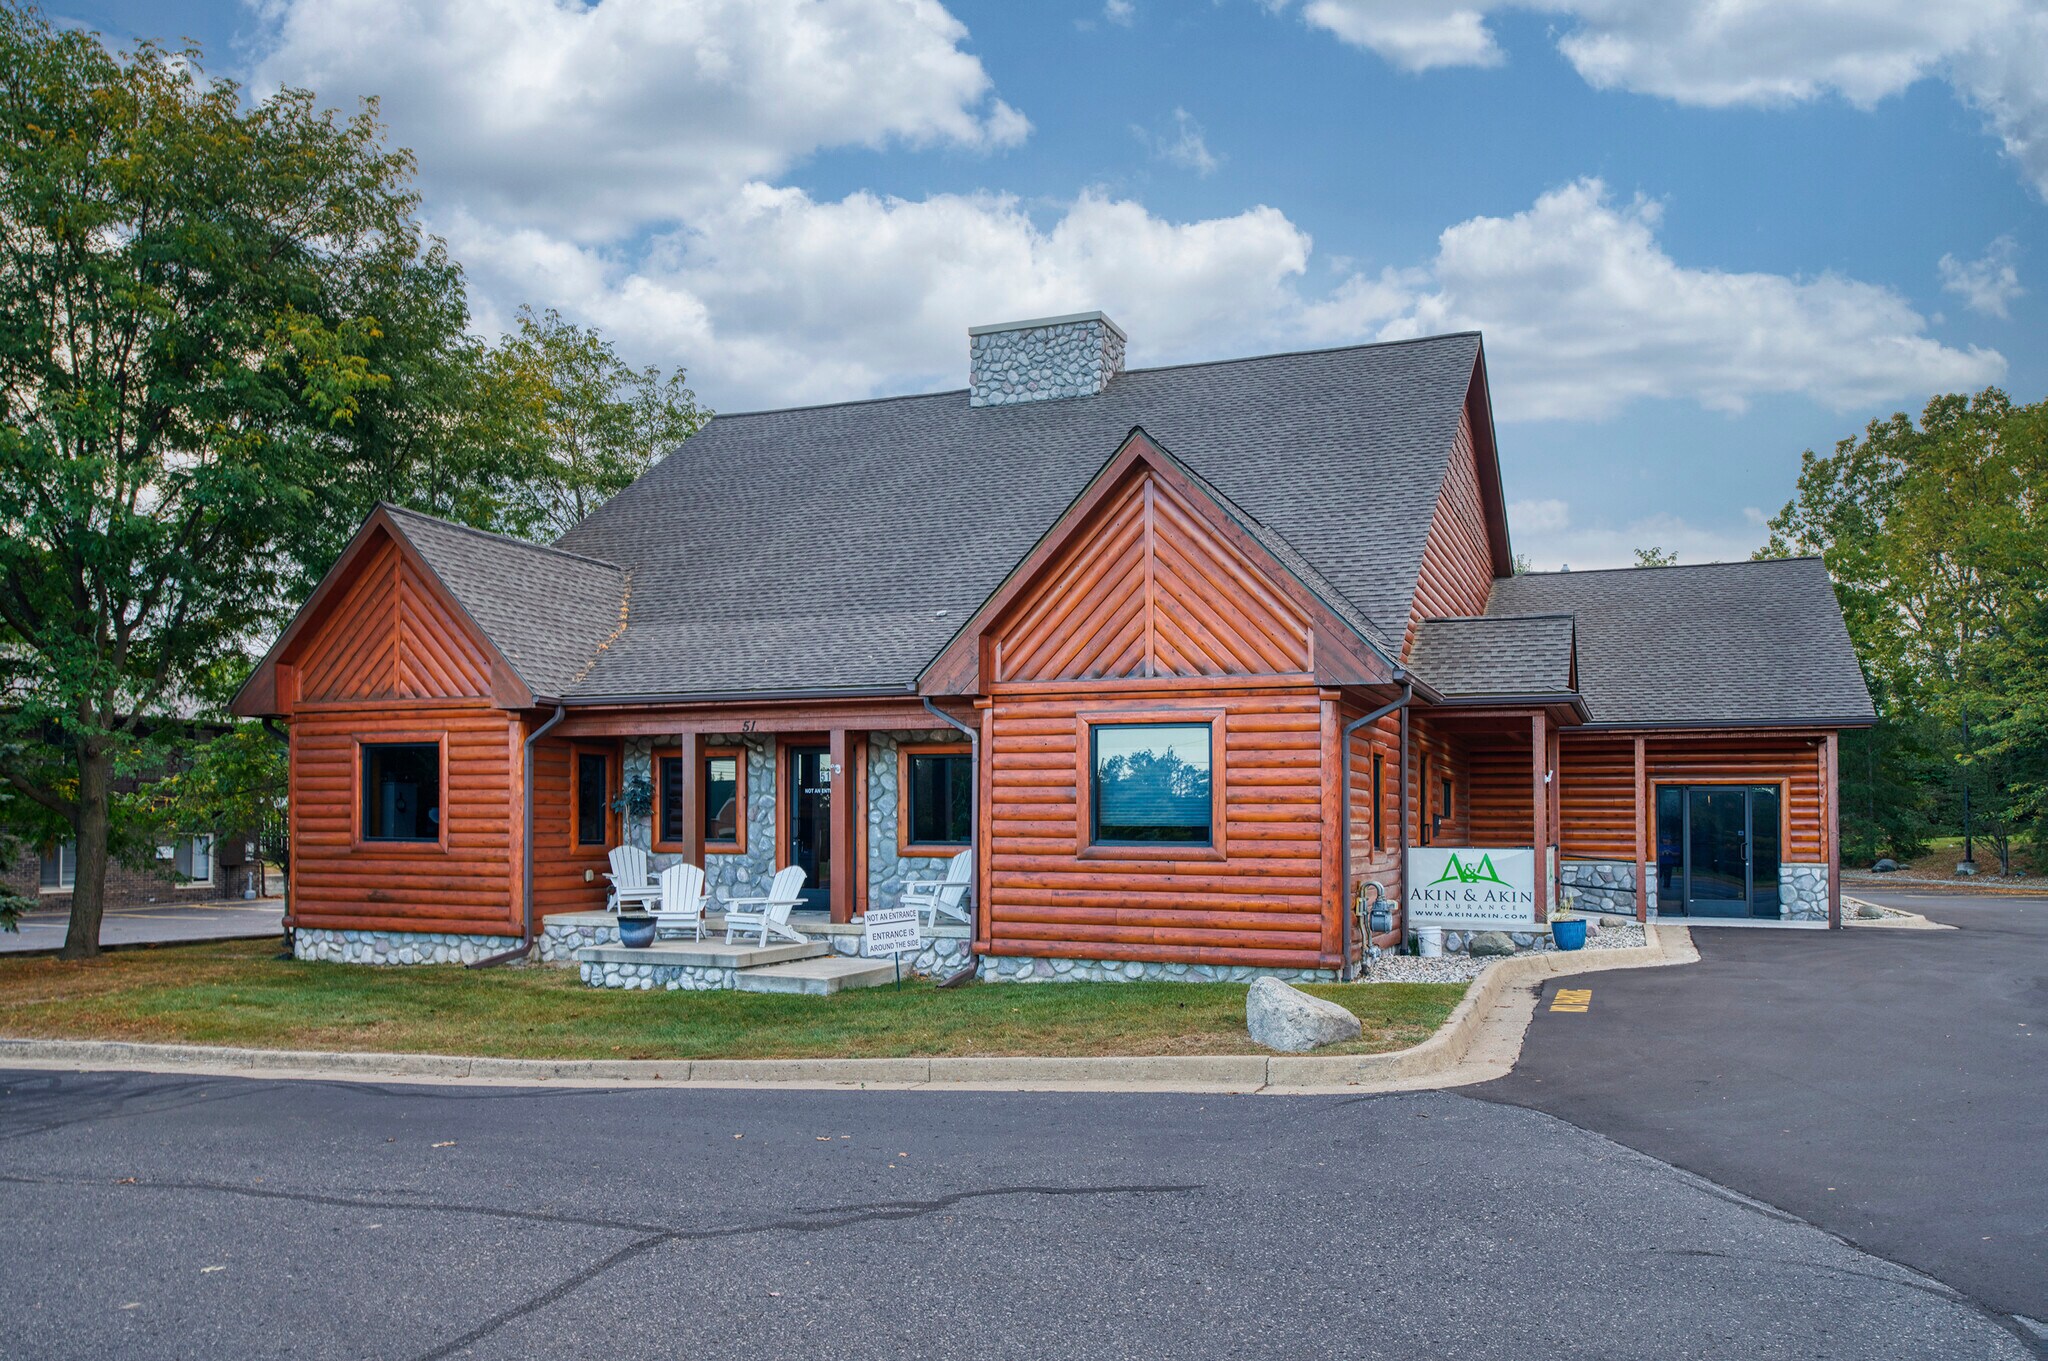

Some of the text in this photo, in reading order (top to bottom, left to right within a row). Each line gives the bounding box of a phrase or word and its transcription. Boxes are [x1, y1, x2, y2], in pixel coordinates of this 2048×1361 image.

[742, 720, 756, 731] 51
[820, 772, 830, 781] 51
[1410, 888, 1532, 903] AKIN & AKIN
[1424, 902, 1518, 911] INSURANCE
[866, 910, 917, 922] NOT AN ENTRANCE
[1415, 910, 1528, 920] WWW.AKINAKIN.COM
[872, 928, 915, 940] ENTRANCE IS
[870, 939, 919, 952] AROUND THE SIDE
